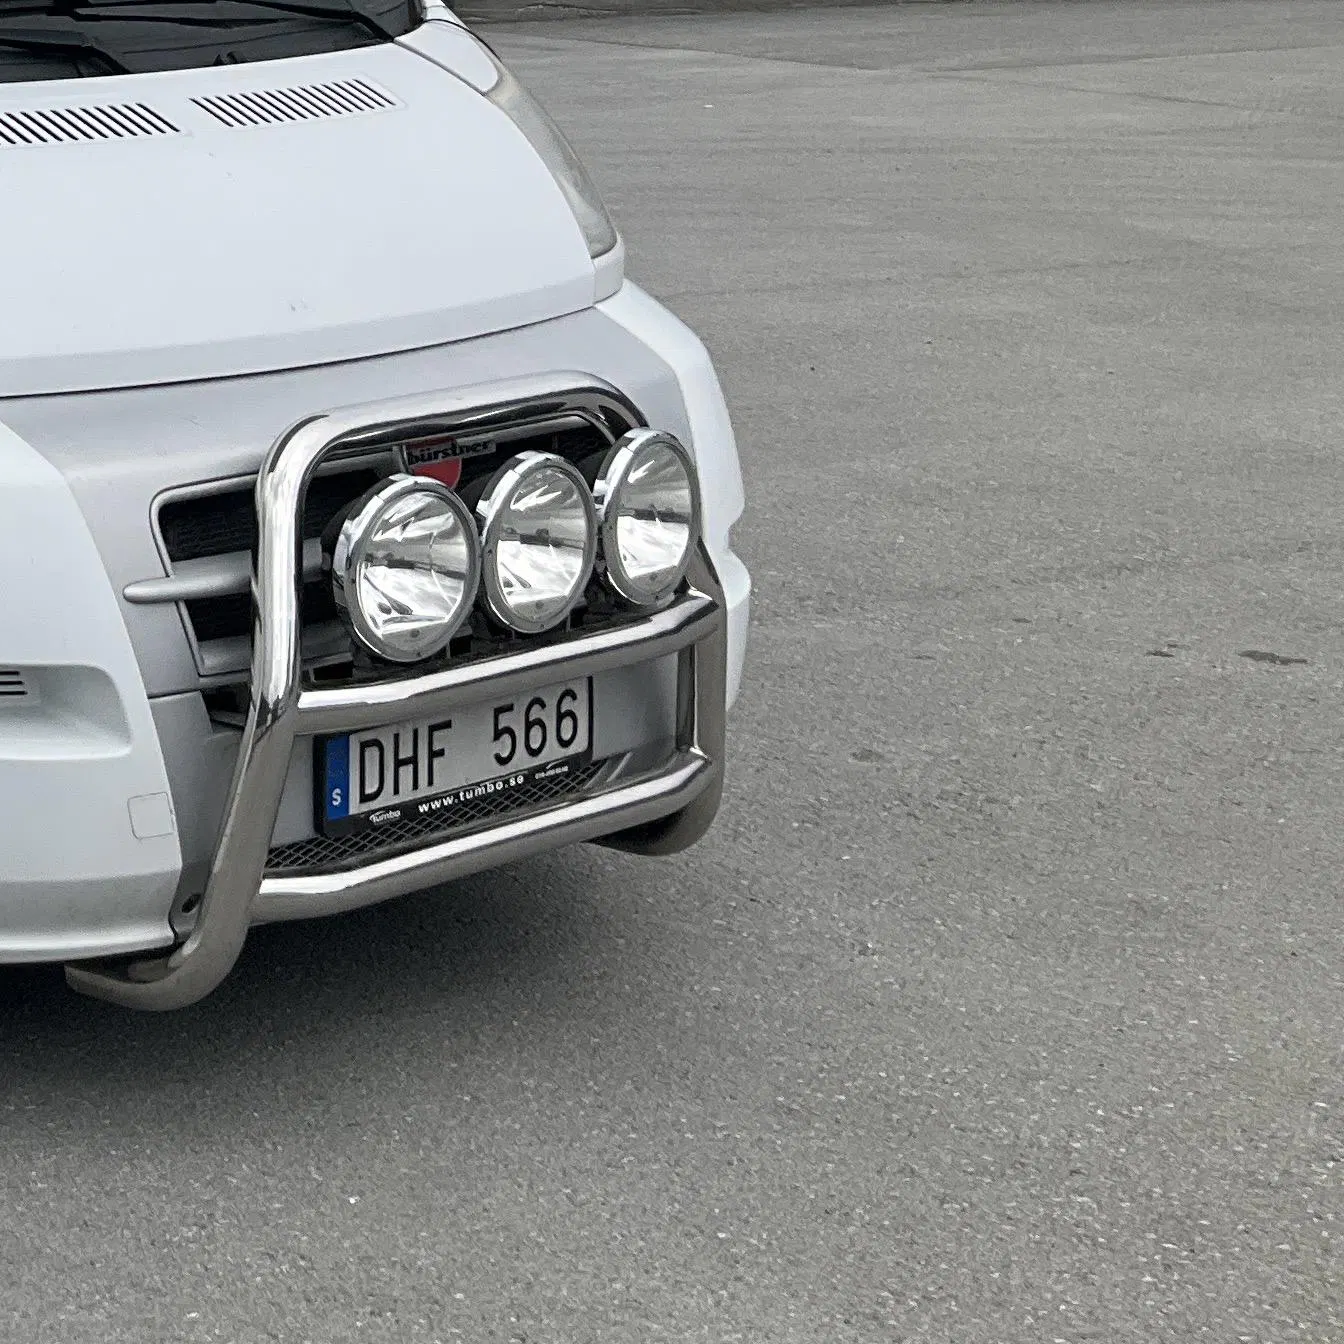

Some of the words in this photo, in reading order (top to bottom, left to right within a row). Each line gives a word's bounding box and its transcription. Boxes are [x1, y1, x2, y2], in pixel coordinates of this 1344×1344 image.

[359, 718, 453, 805] DHF
[492, 687, 579, 767] 566
[332, 787, 342, 806] S
[418, 774, 524, 813] www.tumbo.se
